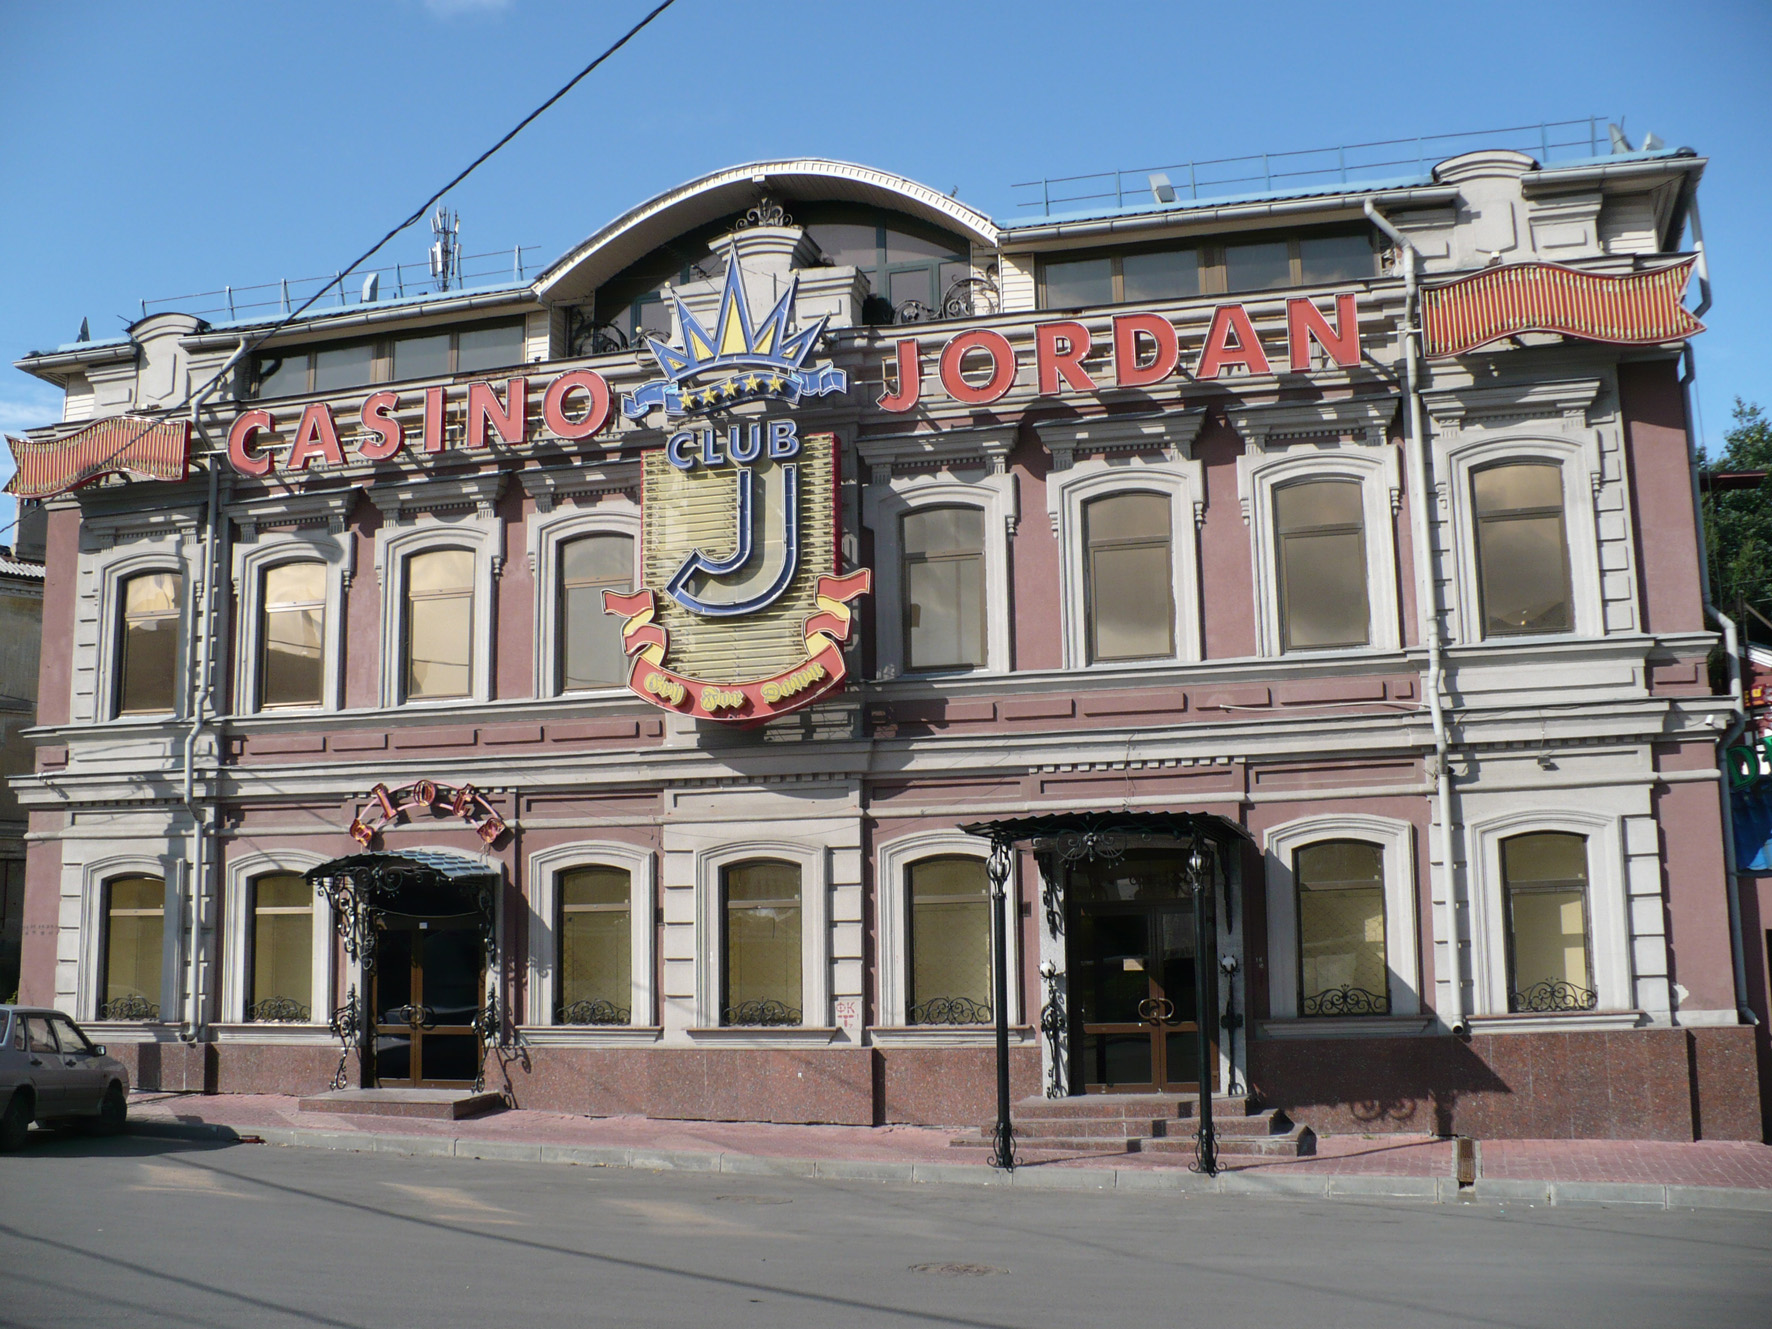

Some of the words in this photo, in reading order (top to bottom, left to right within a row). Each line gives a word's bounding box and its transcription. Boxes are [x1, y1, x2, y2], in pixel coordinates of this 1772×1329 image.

[875, 292, 1361, 414] JORDAN
[226, 367, 614, 478] CASINO
[665, 418, 801, 470] CLUB
[664, 462, 798, 617] J
[643, 671, 688, 708] Cry
[700, 685, 746, 713] For
[760, 661, 827, 706] Dawn
